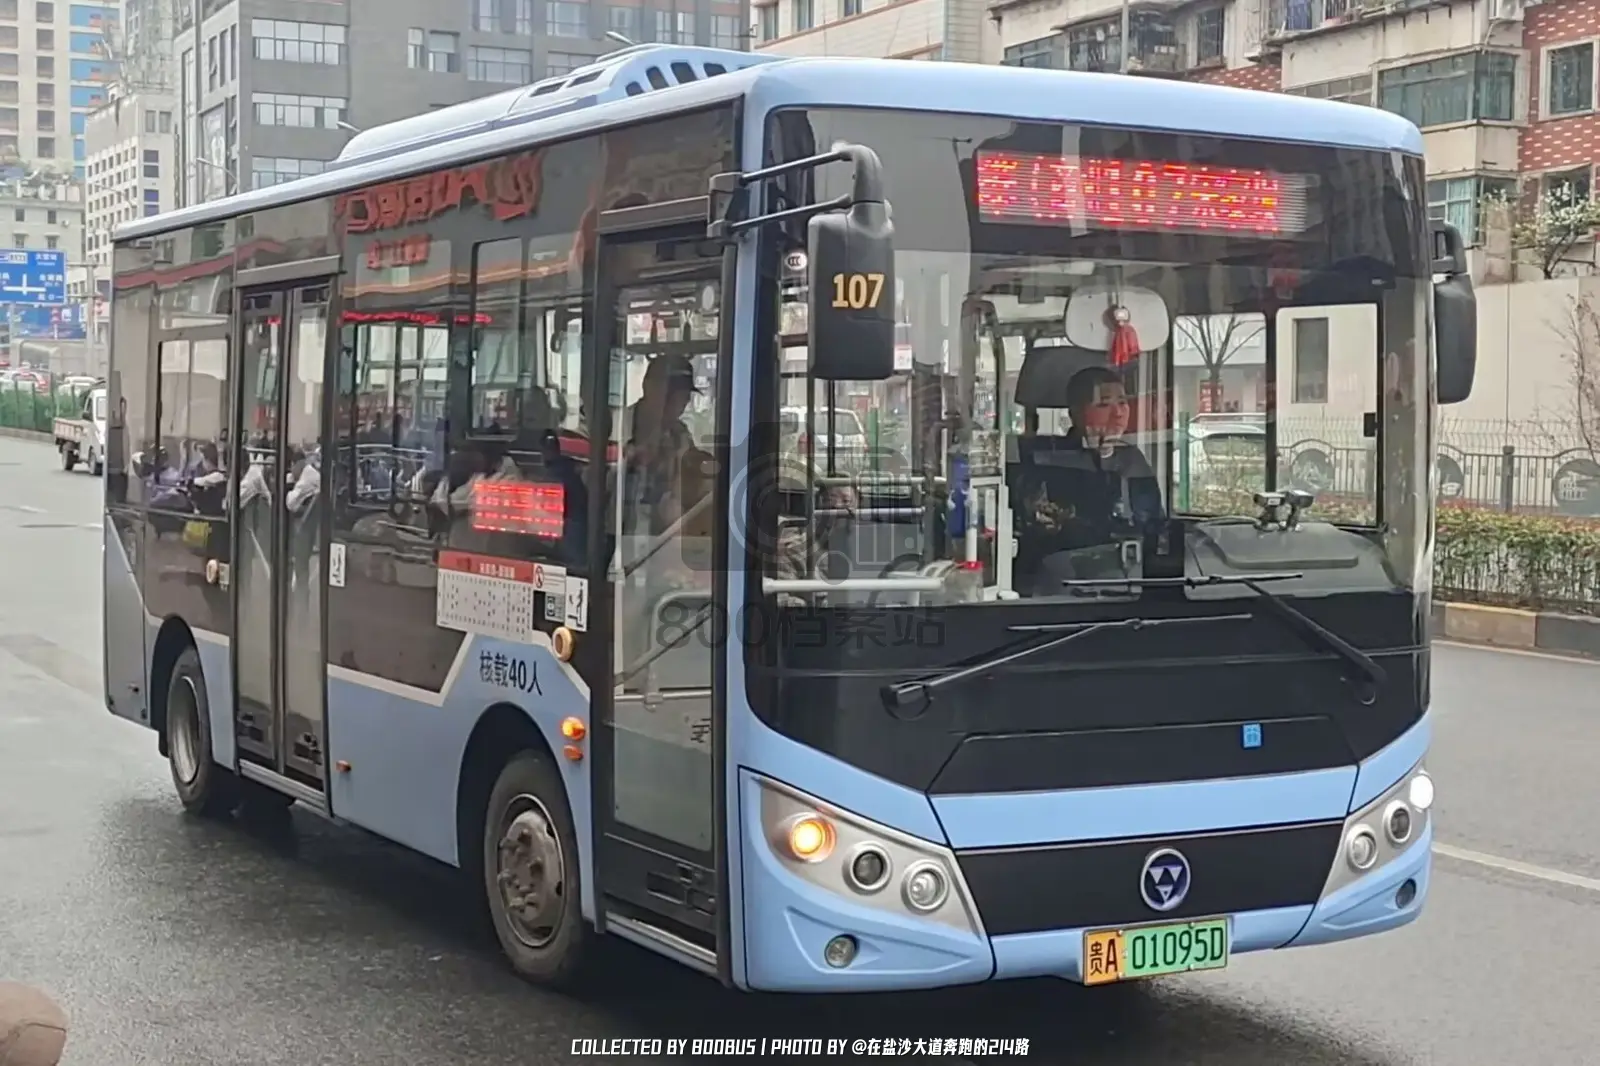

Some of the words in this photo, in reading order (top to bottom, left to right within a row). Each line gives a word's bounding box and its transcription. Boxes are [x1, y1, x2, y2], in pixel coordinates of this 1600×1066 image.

[832, 273, 885, 309] 107
[480, 650, 542, 696] 核载40人
